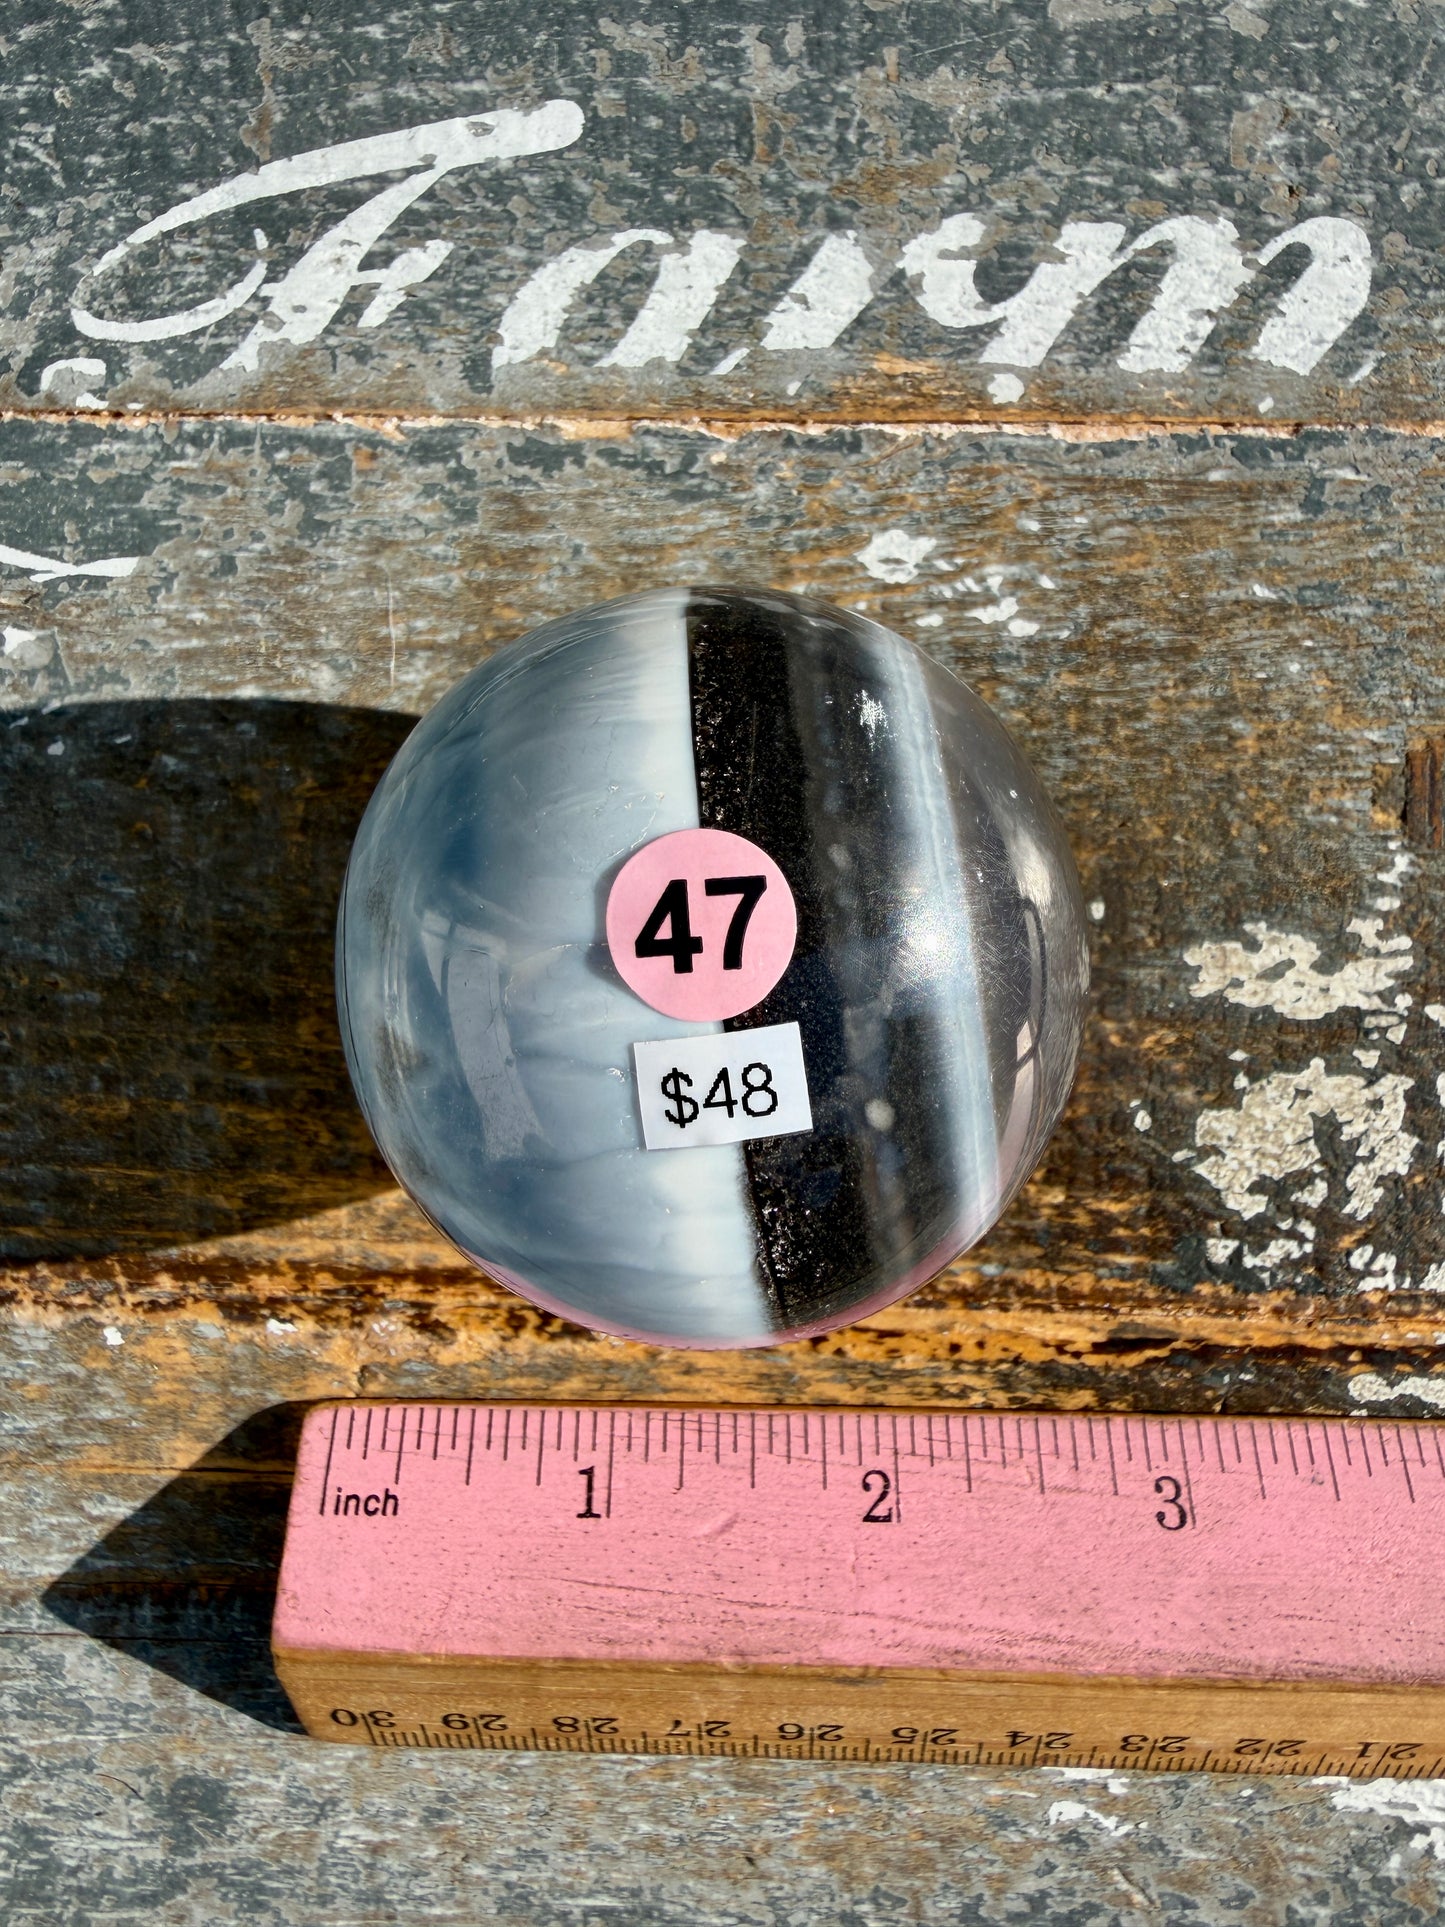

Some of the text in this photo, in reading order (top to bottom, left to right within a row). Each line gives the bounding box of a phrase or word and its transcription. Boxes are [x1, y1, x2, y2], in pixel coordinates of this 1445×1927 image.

[635, 875, 767, 974] 47
[661, 1062, 778, 1129] $48
[333, 1465, 1187, 1531] inch 1 2 3
[330, 1708, 1424, 1761] 21 22 23 24 25 26 27 28 29 30
